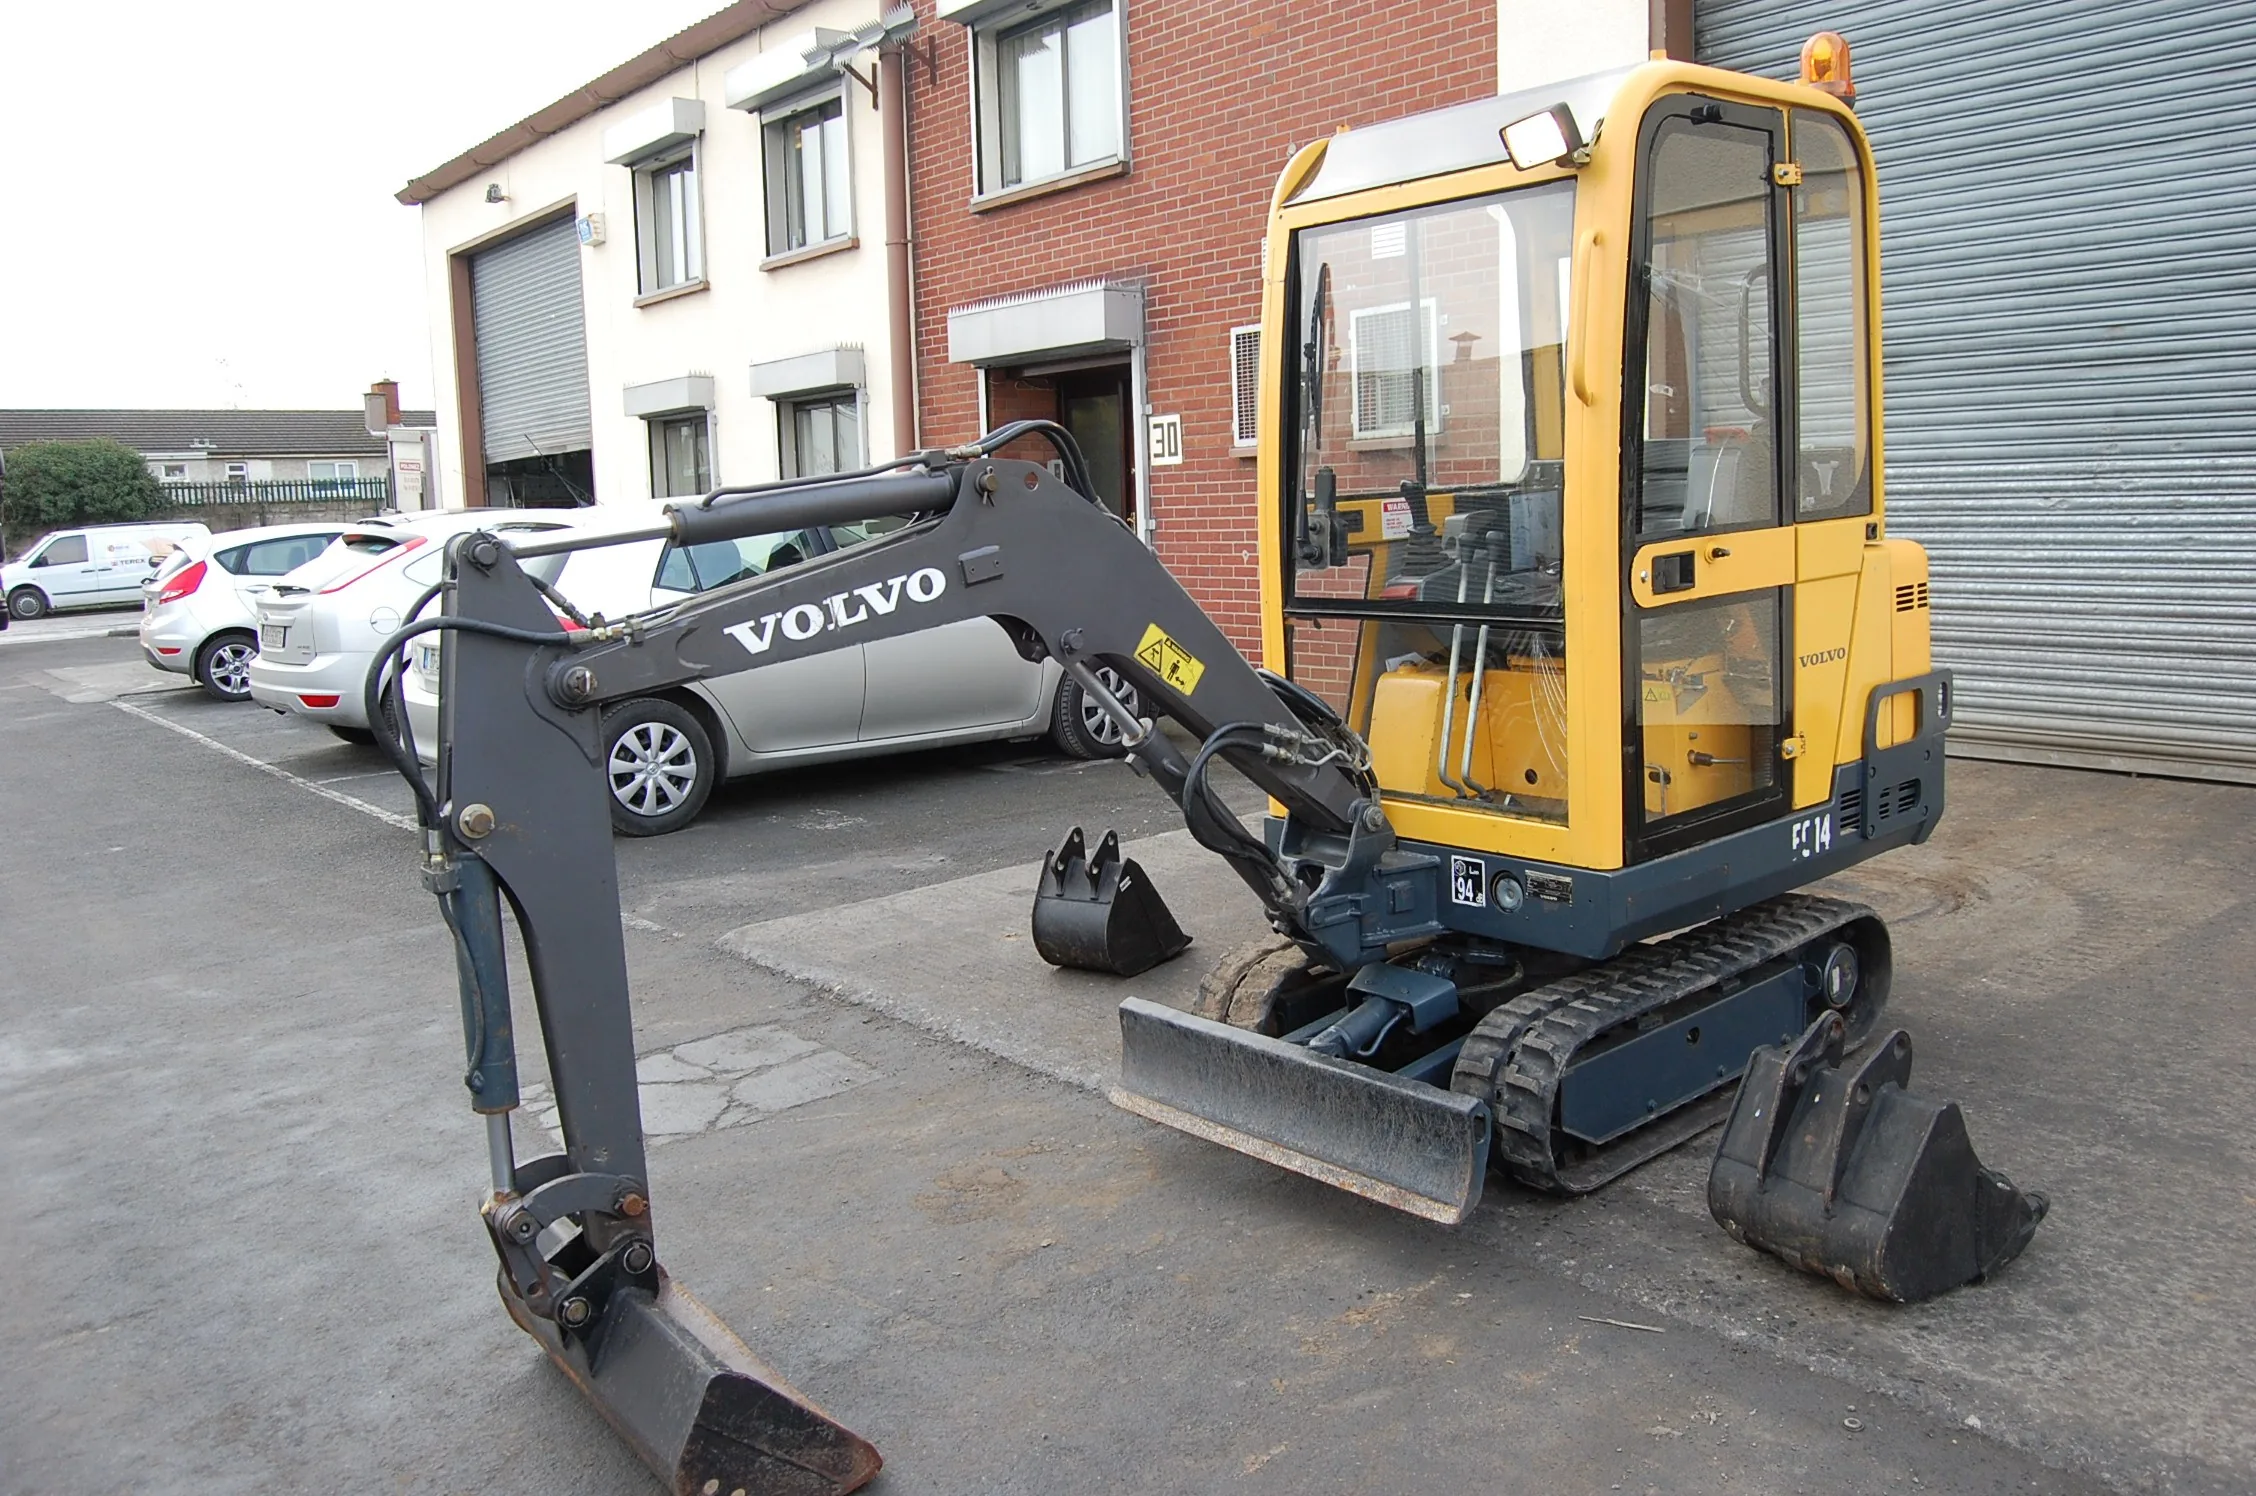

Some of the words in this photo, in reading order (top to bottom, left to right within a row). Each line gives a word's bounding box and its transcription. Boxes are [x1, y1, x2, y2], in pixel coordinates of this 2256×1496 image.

[1153, 422, 1178, 457] 30
[723, 567, 947, 655] VOLVO
[1798, 647, 1846, 668] VOLVO
[1457, 876, 1474, 902] 94
